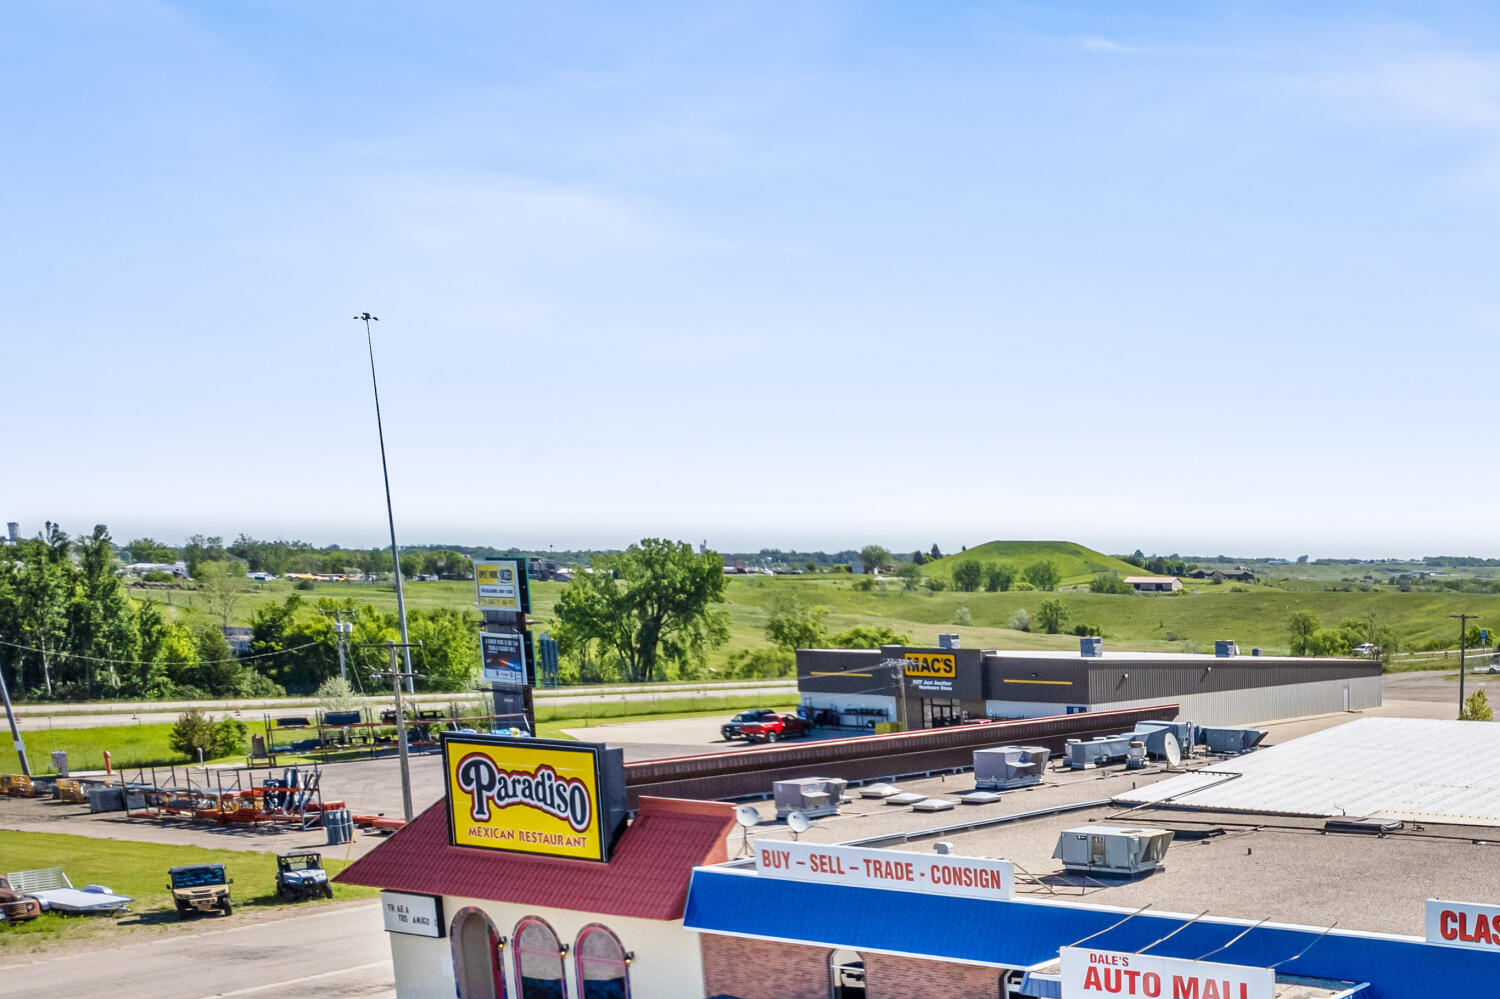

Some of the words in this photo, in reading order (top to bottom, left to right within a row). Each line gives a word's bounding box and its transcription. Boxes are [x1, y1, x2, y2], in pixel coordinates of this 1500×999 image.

[906, 656, 953, 673] MAC'S
[459, 756, 590, 830] Paradiso
[468, 826, 515, 840] MEXICAN
[518, 830, 587, 848] RESTAURANT
[761, 849, 791, 870] BUY
[810, 853, 845, 875] SELL
[863, 858, 915, 882] TRADE
[931, 864, 1001, 889] CONSIGN
[1090, 953, 1129, 967] DALE'S
[1083, 966, 1161, 997] AUTO
